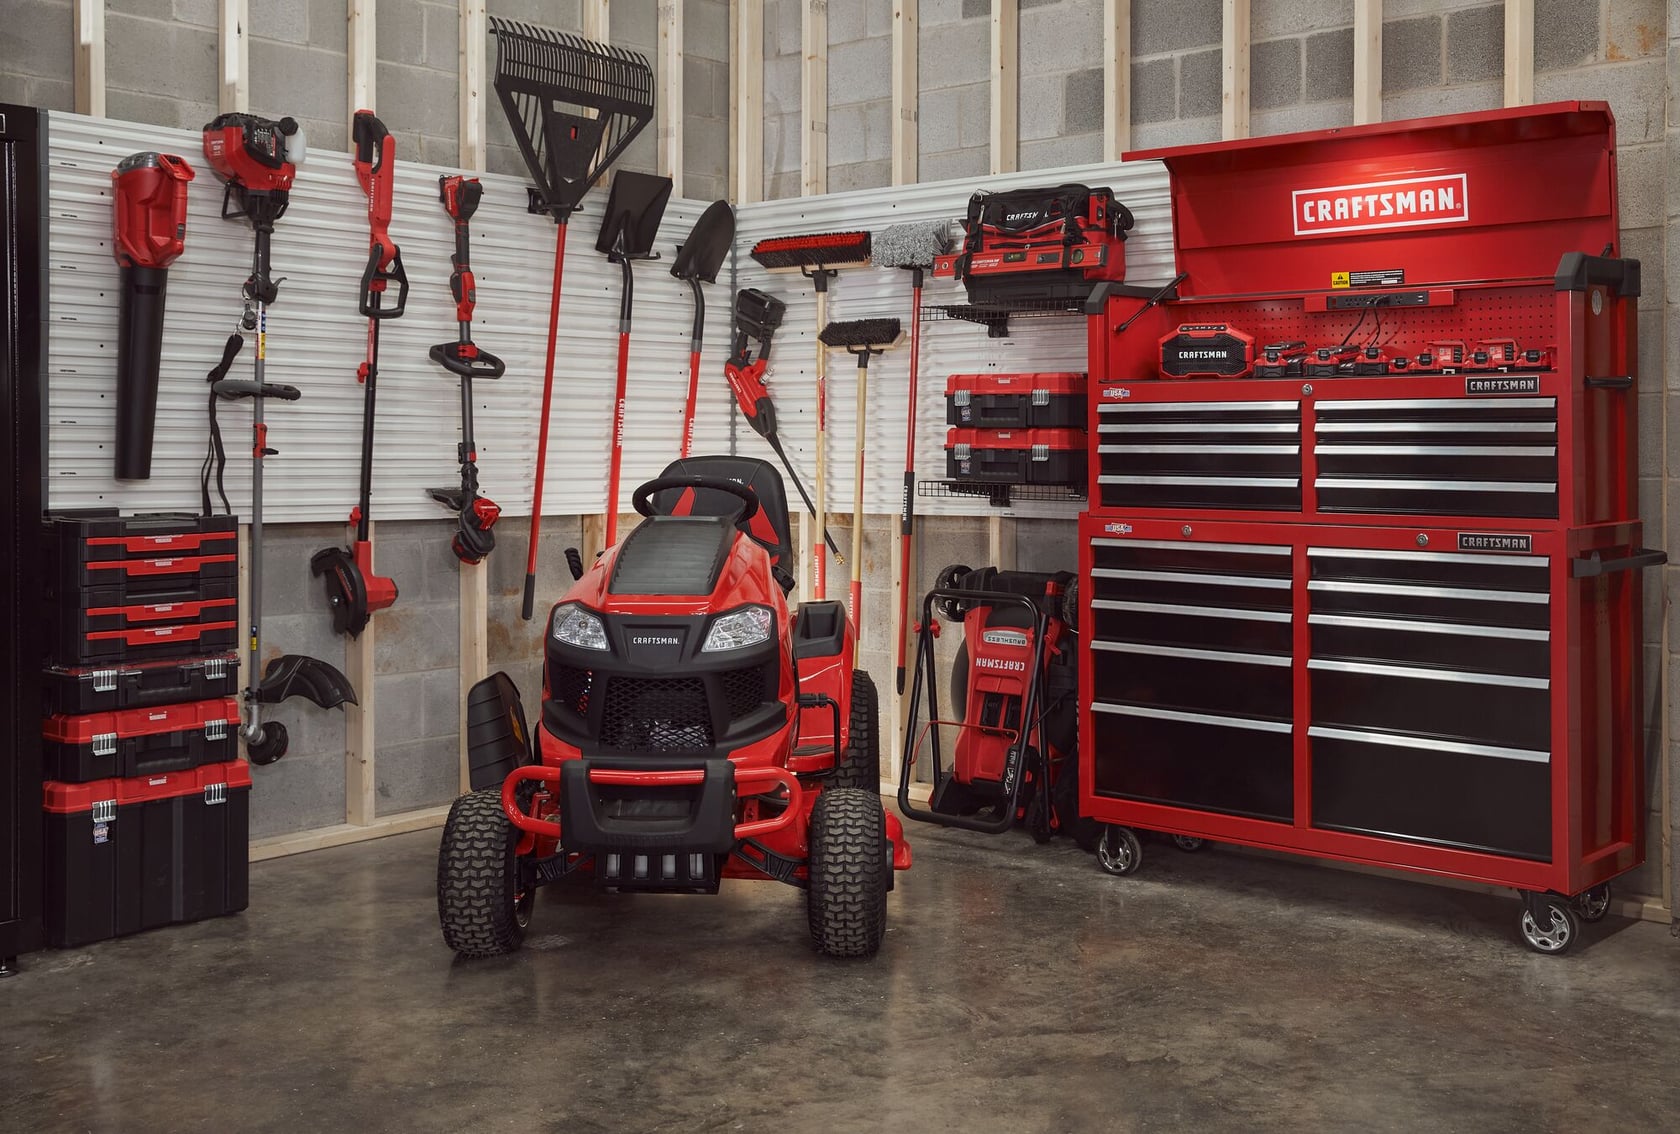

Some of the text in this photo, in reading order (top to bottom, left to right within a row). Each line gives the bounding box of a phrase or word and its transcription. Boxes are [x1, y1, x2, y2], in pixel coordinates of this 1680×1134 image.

[1303, 187, 1455, 223] CRAFTSMAN
[1178, 350, 1228, 359] CRAFTSMAN
[1470, 380, 1534, 391] CRAFTSMAN
[615, 398, 626, 448] CRAFTSMAN
[1462, 536, 1527, 549] CRAFTSMAN
[633, 637, 680, 645] CRAFTSMAN
[975, 657, 1025, 672] CRAFTSMAN
